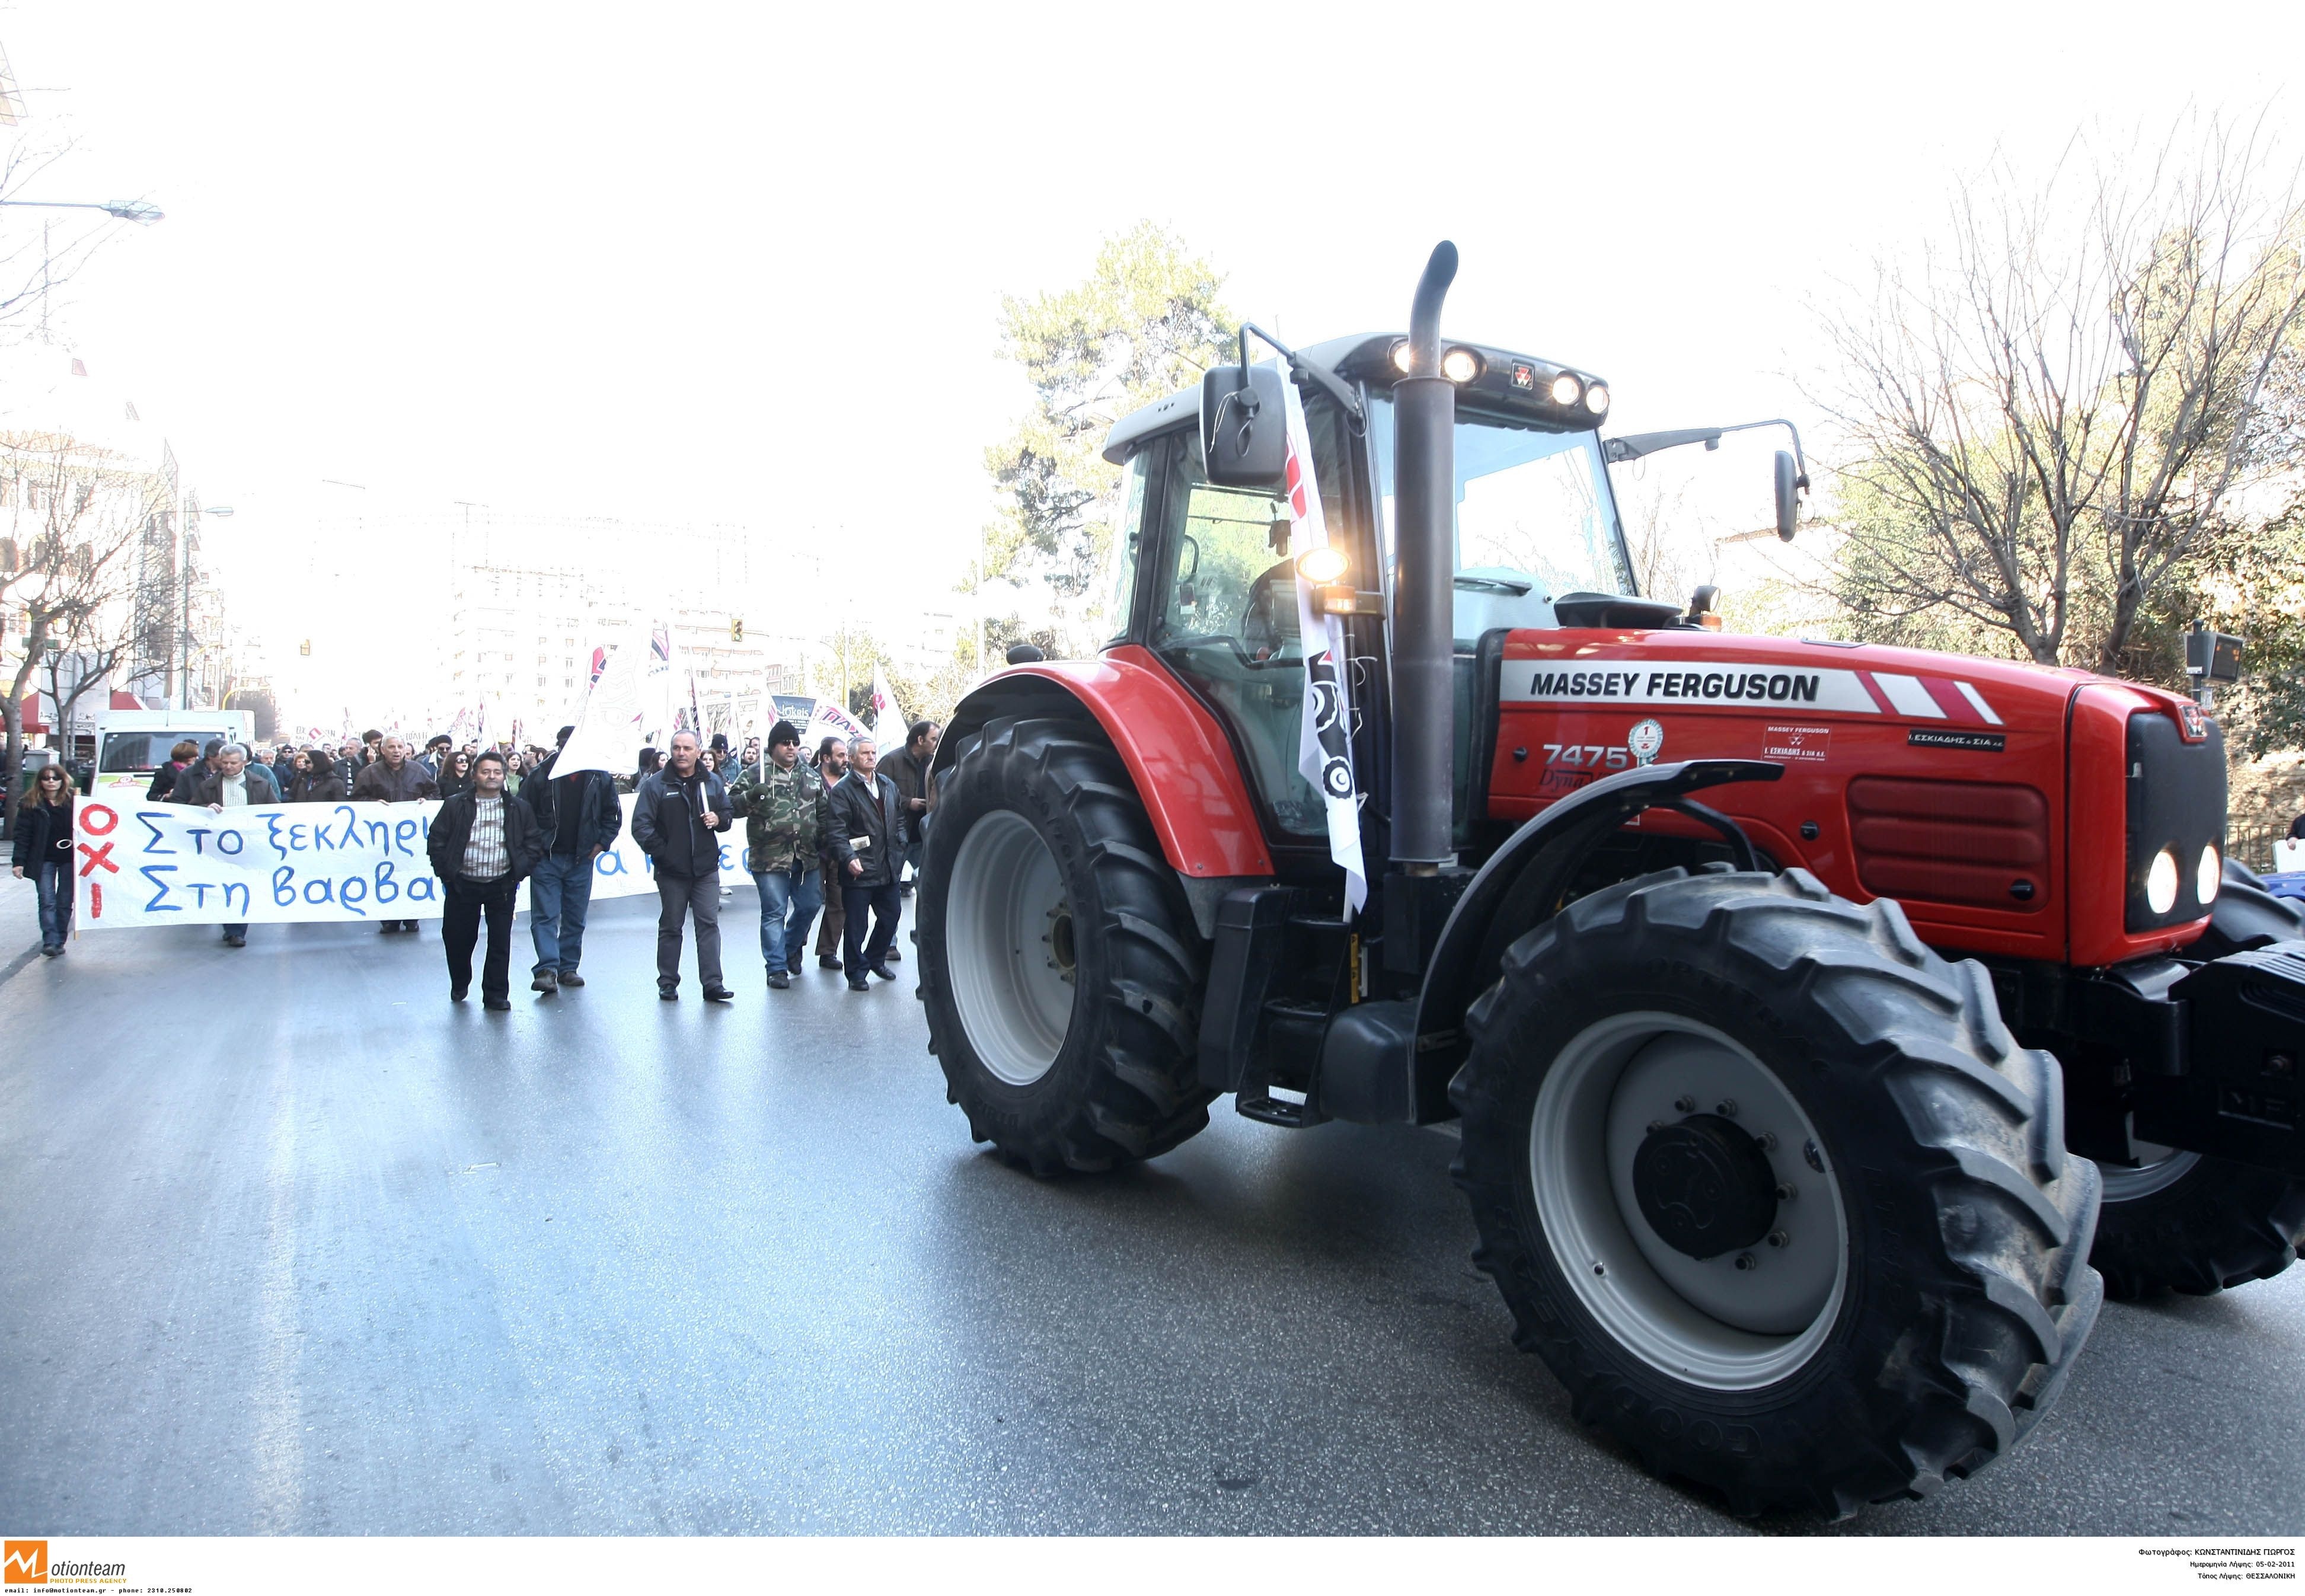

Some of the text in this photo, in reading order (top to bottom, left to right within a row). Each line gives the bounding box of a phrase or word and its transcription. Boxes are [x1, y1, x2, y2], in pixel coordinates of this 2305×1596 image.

[1530, 672, 1820, 701] MASSEY FERGUSON
[1770, 747, 1800, 755] ΕΣΚΙΑΔΗΣ
[1914, 734, 1965, 745] ΕΣΚΙΑΔΗΣ
[1543, 744, 1628, 770] 7475
[136, 812, 244, 855] Στο
[77, 804, 120, 919] ΟΧΙ
[139, 865, 250, 917] Στη
[273, 861, 446, 916] βαρβα
